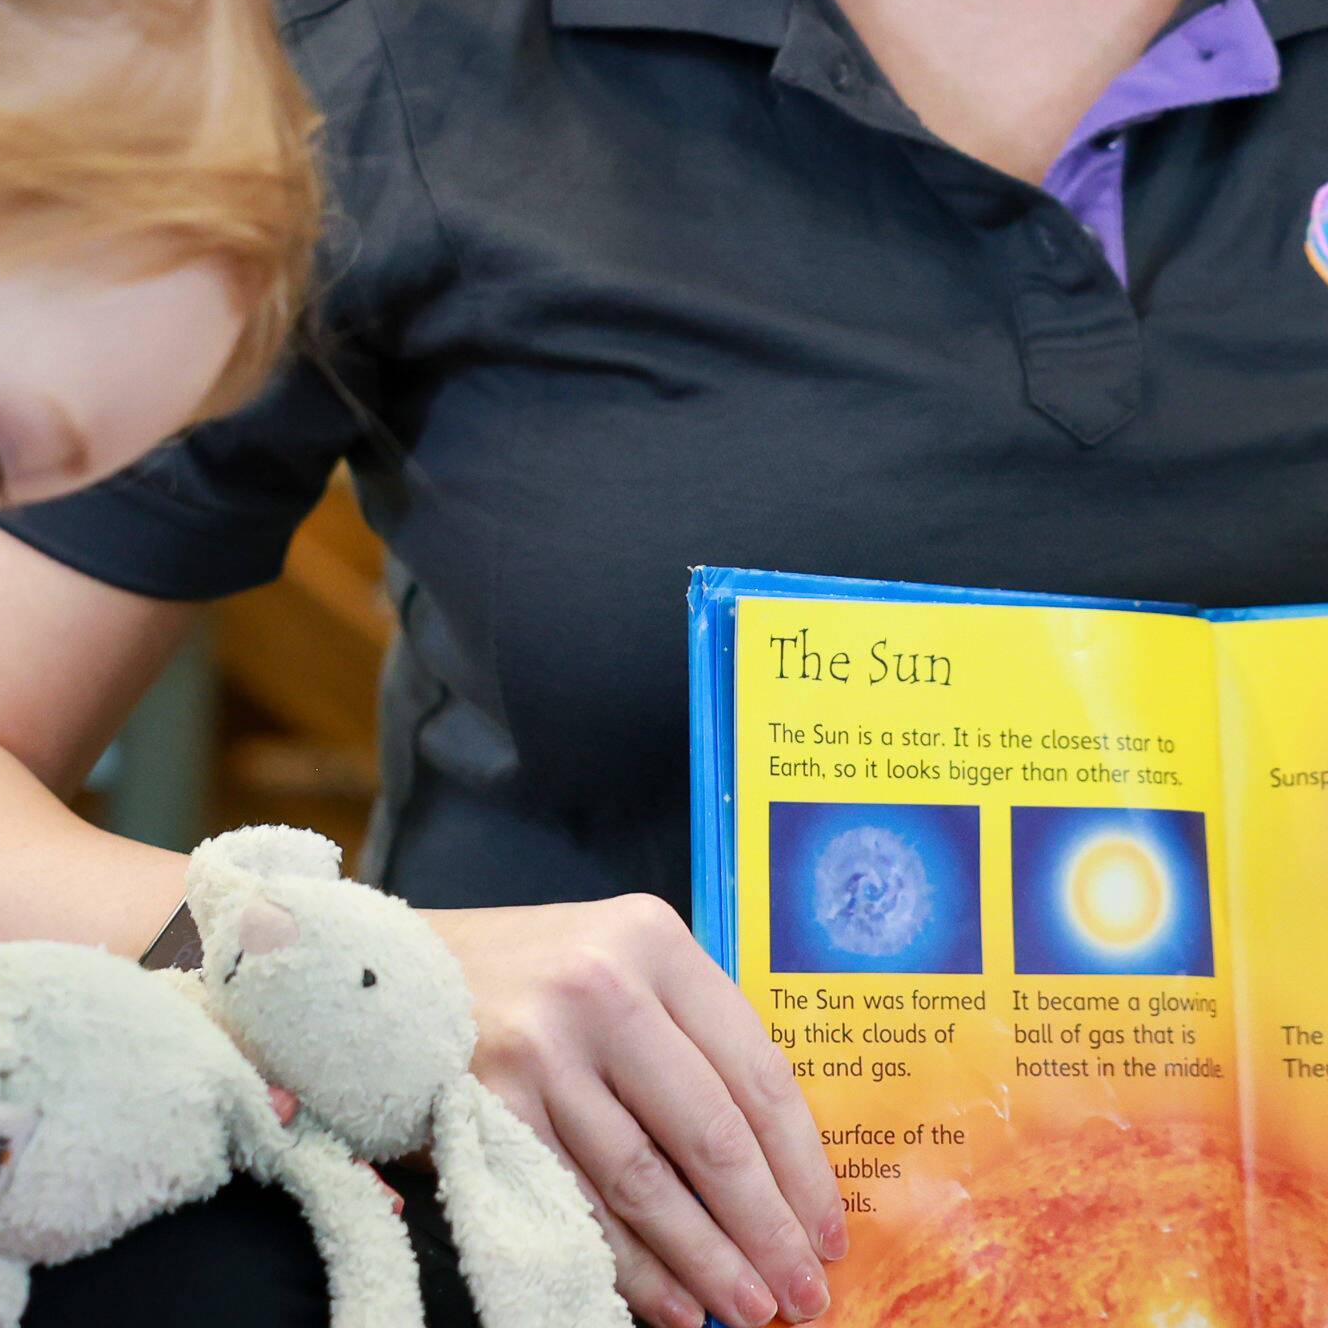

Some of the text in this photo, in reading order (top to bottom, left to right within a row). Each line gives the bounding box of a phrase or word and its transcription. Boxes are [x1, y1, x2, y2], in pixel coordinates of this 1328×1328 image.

[770, 627, 952, 687] The Sun
[769, 722, 1175, 754] The Sun is a star. It is the closest star to
[769, 756, 1182, 786] Earth, so it looks bigger than other stars.
[770, 989, 986, 1011] The Sun was formed
[1013, 990, 1216, 1018] It became a glowing
[771, 1023, 955, 1047] by thick clouds of
[1014, 1024, 1195, 1049] ball of gas that is
[1282, 1025, 1323, 1045] The
[793, 1056, 911, 1082] st and gas.
[1016, 1057, 1089, 1077] hottest
[1097, 1057, 1115, 1077] in
[1123, 1057, 1156, 1077] the
[821, 1124, 965, 1145] surface of the
[830, 1158, 901, 1179] ubbles
